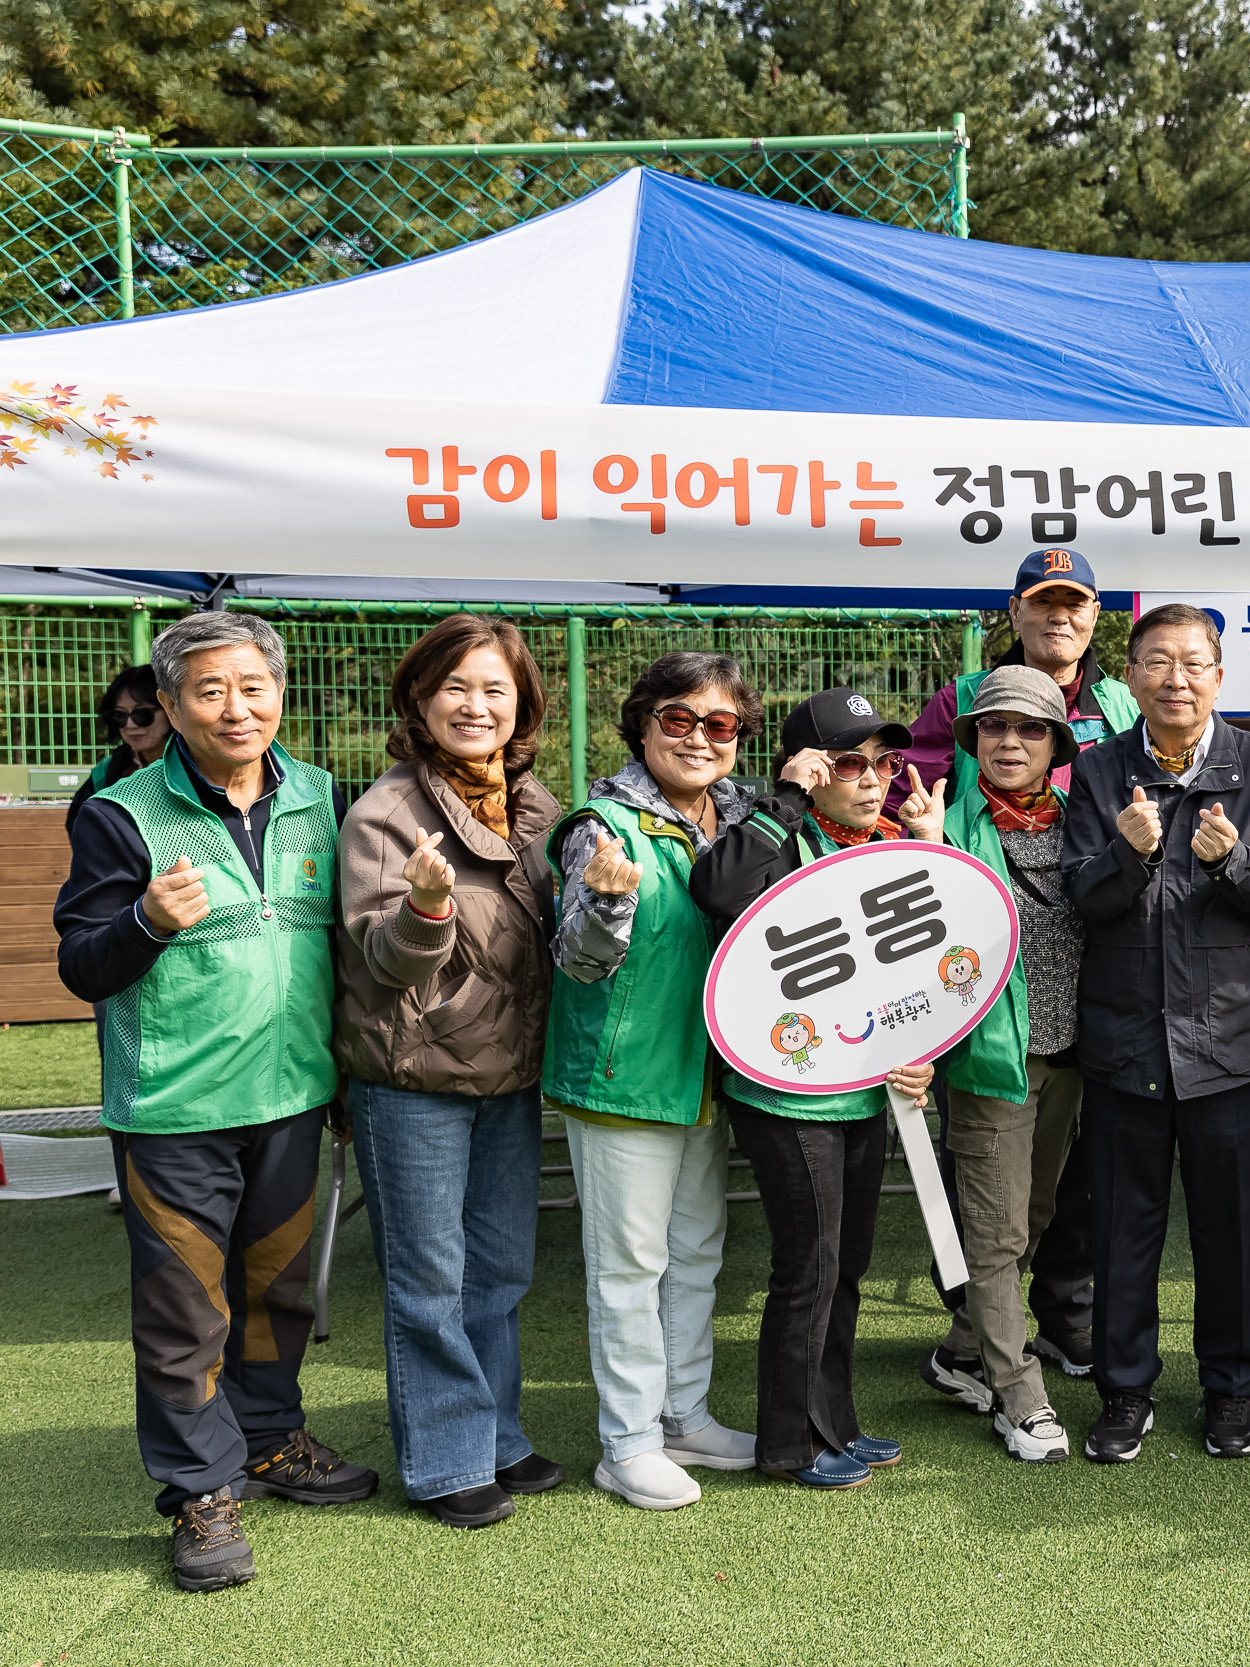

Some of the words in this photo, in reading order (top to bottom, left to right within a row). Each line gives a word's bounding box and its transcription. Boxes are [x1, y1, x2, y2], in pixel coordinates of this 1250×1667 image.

[385, 445, 558, 529] 감이
[593, 453, 904, 547] 익어가는
[934, 464, 1240, 547] 정감어린
[1043, 549, 1073, 576] B
[301, 880, 322, 891] SMU
[765, 869, 947, 1000] 능동
[880, 998, 932, 1030] 행복광진
